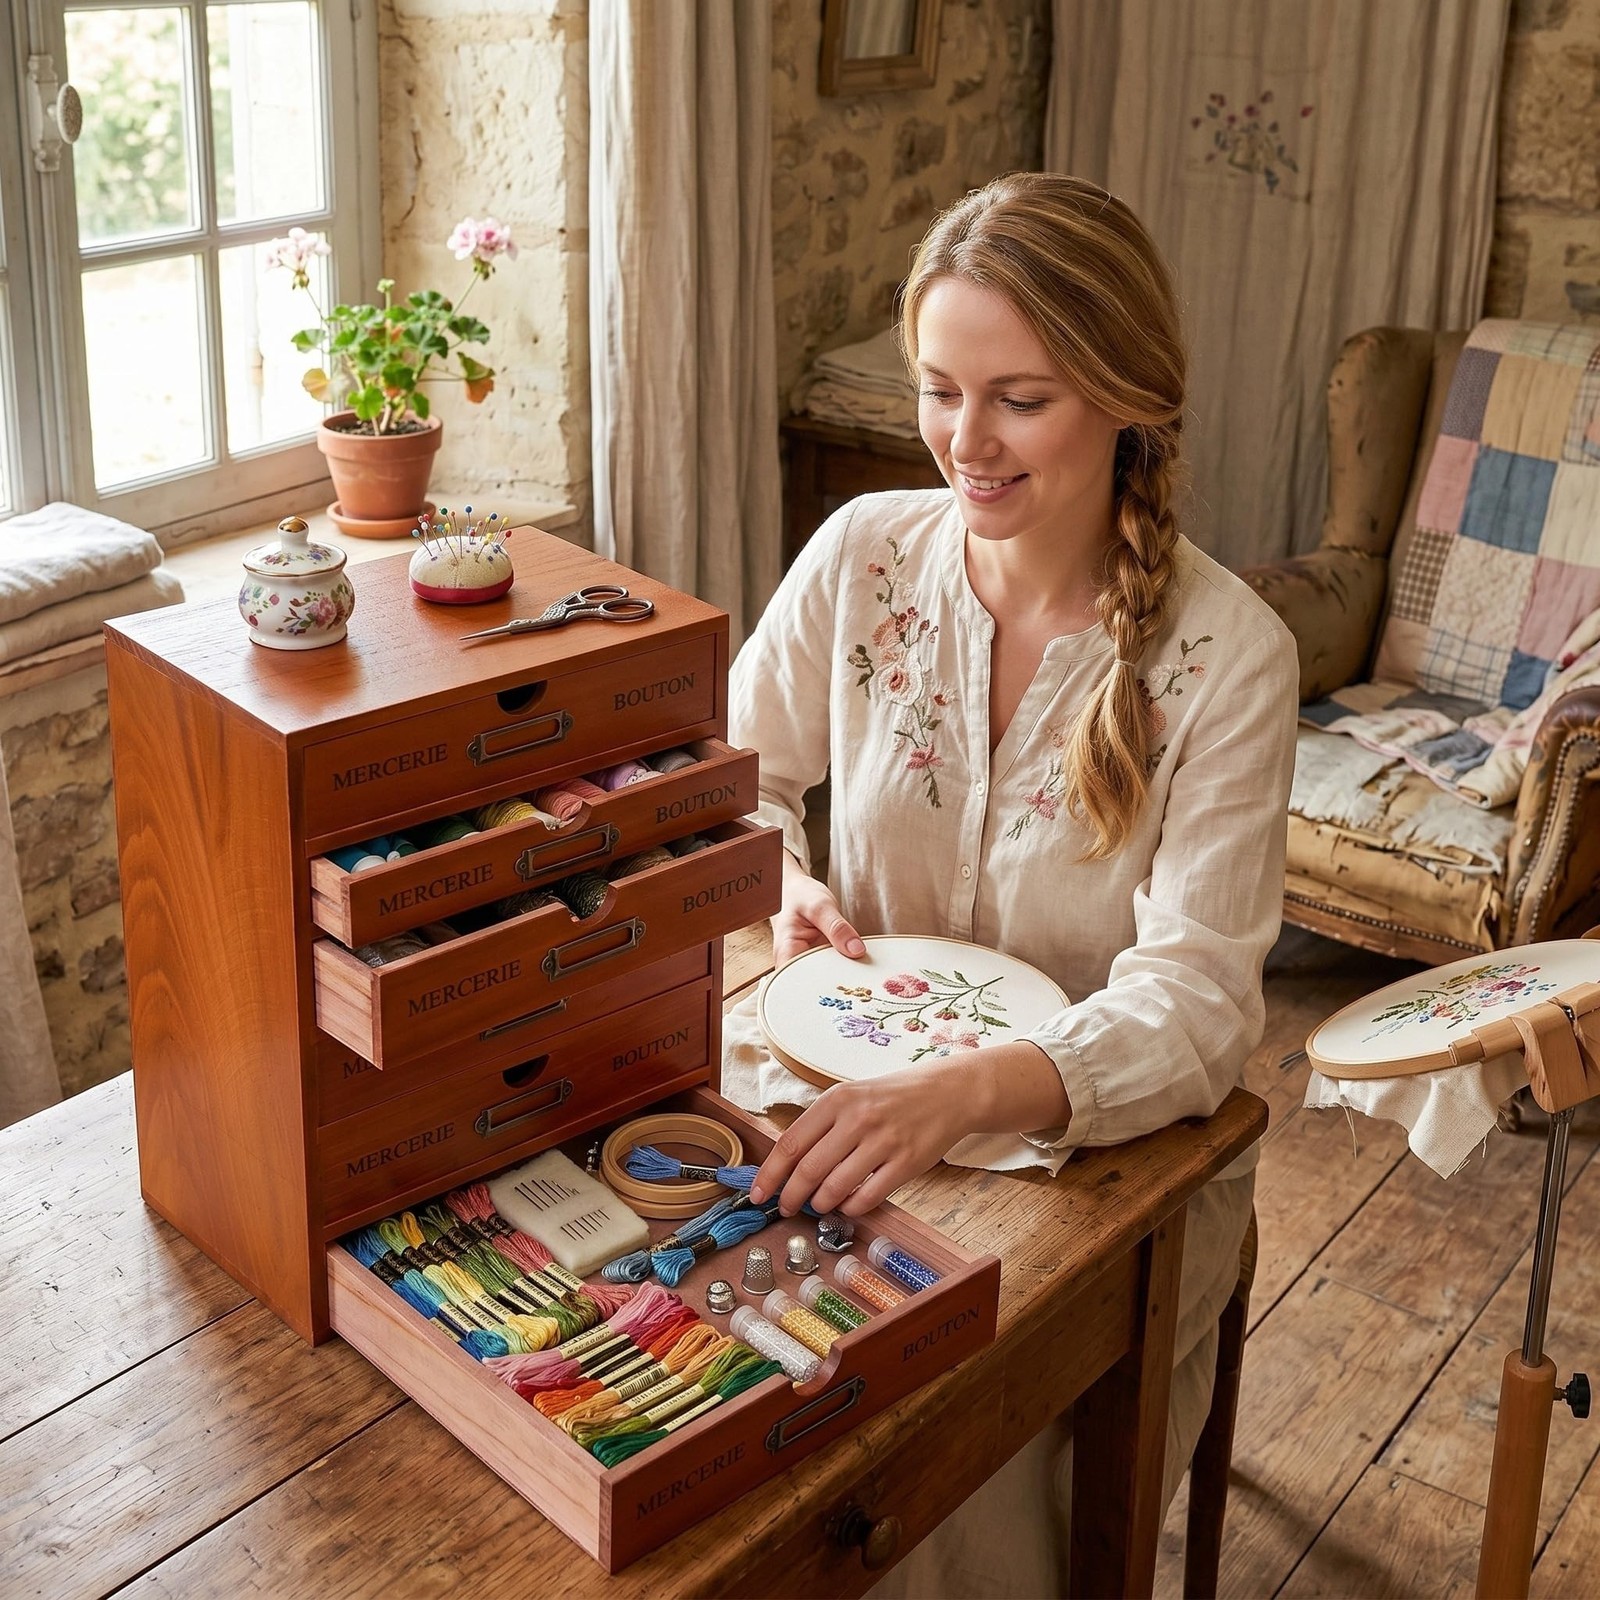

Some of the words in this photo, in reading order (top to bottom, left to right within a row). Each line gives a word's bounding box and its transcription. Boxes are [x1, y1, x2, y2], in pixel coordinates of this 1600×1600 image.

[333, 744, 447, 790] MERCERIE
[614, 673, 695, 711] BOUTON
[379, 864, 493, 916] MERCERIE
[656, 782, 737, 823] BOUTON
[408, 960, 521, 1017] MERCERIE
[682, 870, 763, 914] BOUTON
[346, 1122, 455, 1178] MERCERIE
[613, 1028, 689, 1072] BOUTON
[637, 1442, 746, 1519] MERCERIE
[902, 1305, 980, 1362] BOUTON
